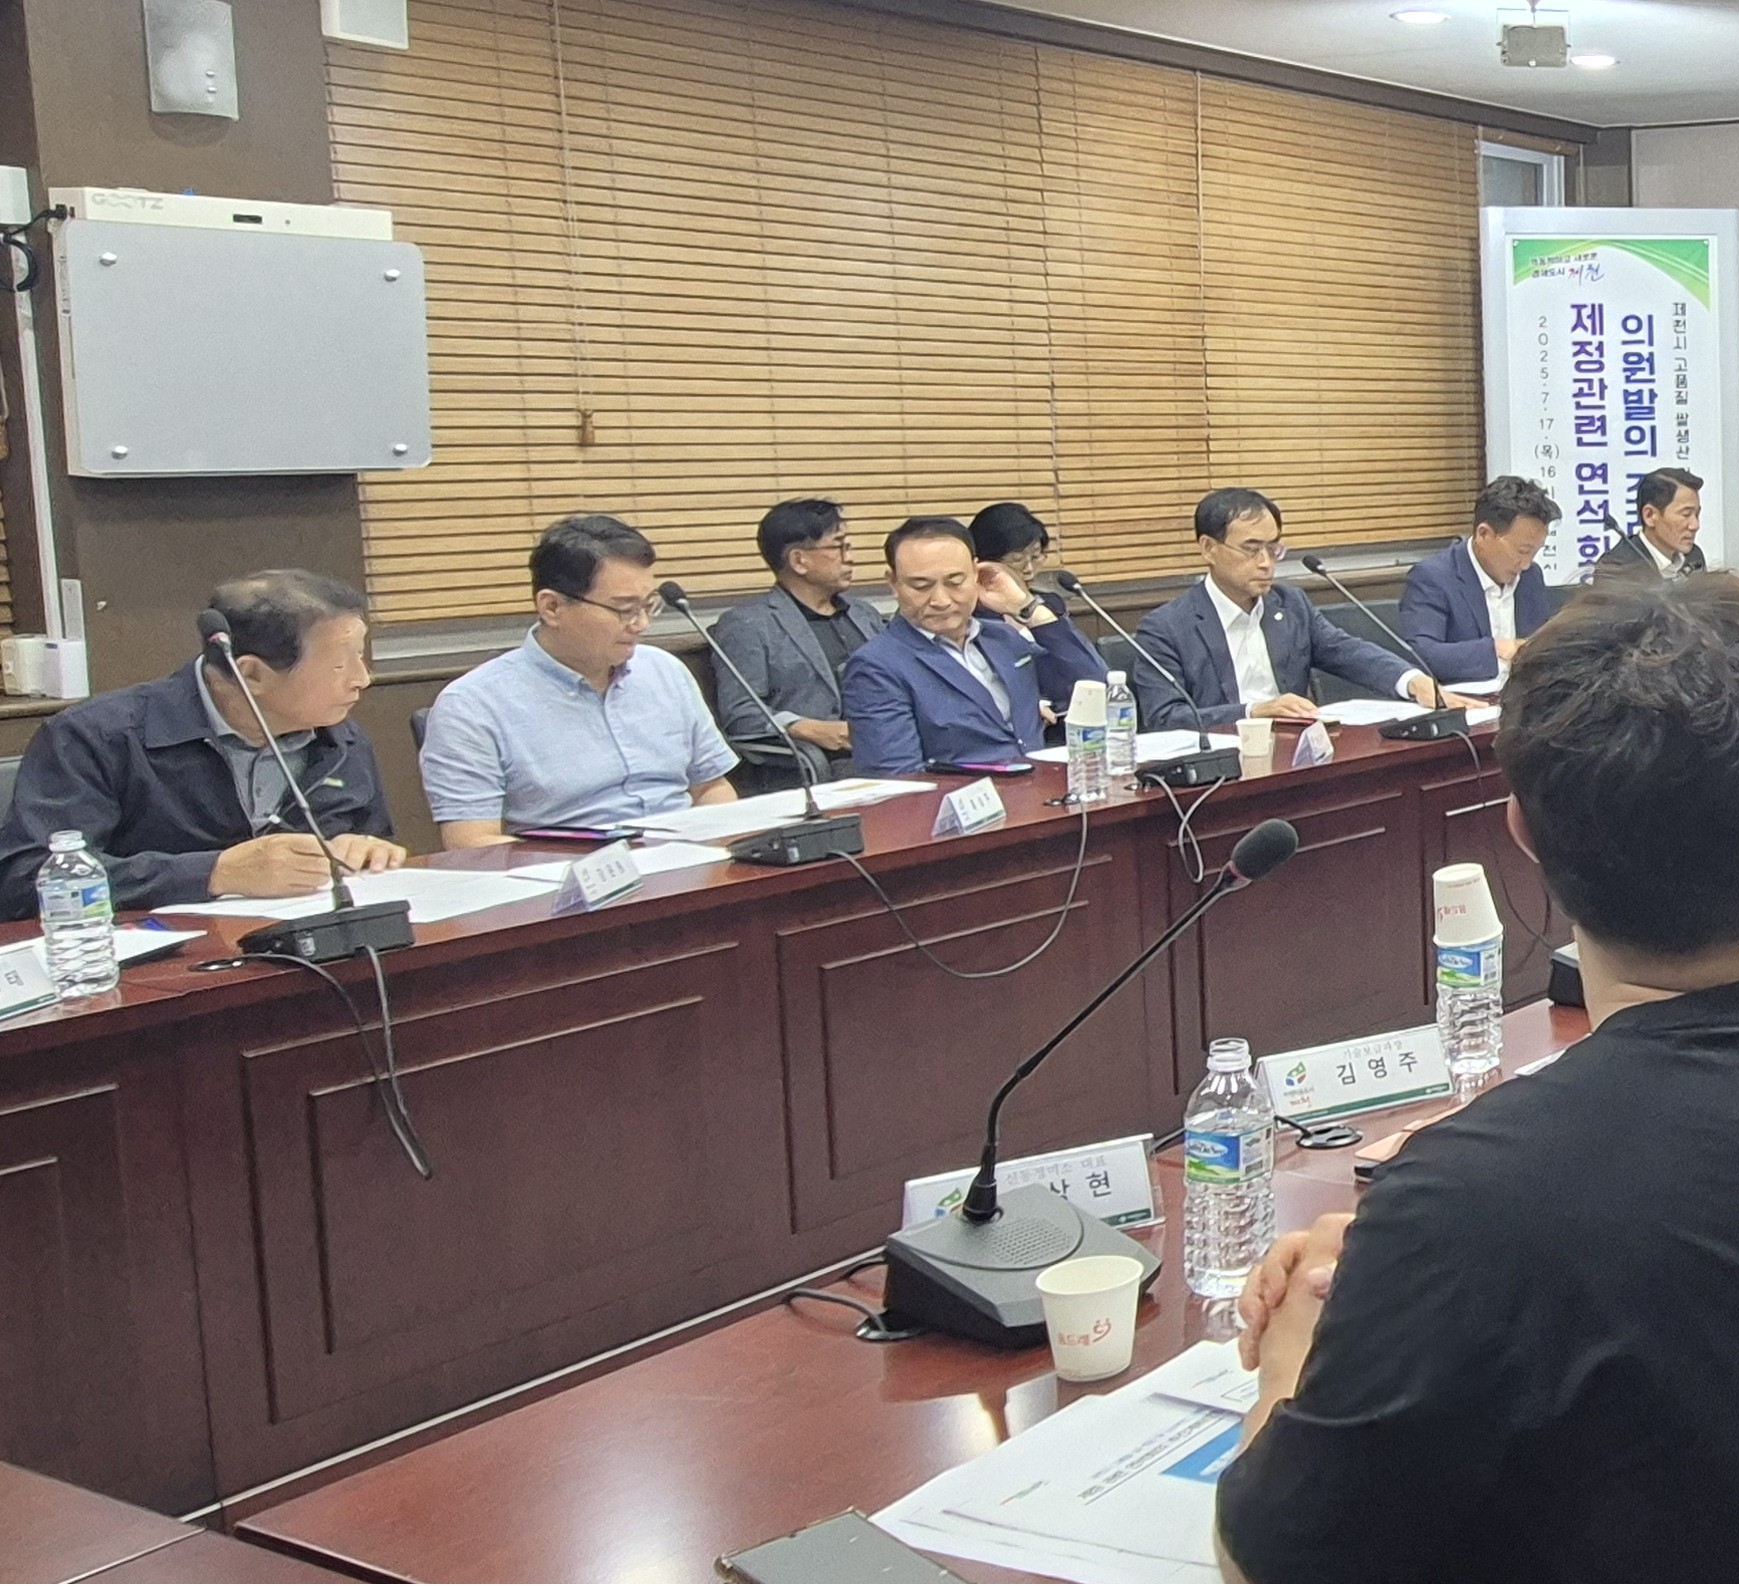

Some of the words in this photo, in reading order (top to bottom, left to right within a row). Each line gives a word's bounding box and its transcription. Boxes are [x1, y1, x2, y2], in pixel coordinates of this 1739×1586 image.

[1672, 302, 1688, 351] 제천시
[1569, 302, 1609, 448] 제정관련
[1620, 313, 1659, 458] 의원발의
[1673, 357, 1689, 406] 고품질
[1675, 412, 1691, 461] 쌀생산
[1574, 461, 1612, 585] 연석회
[1336, 1051, 1419, 1086] 김영주
[1050, 1170, 1112, 1201] 상현
